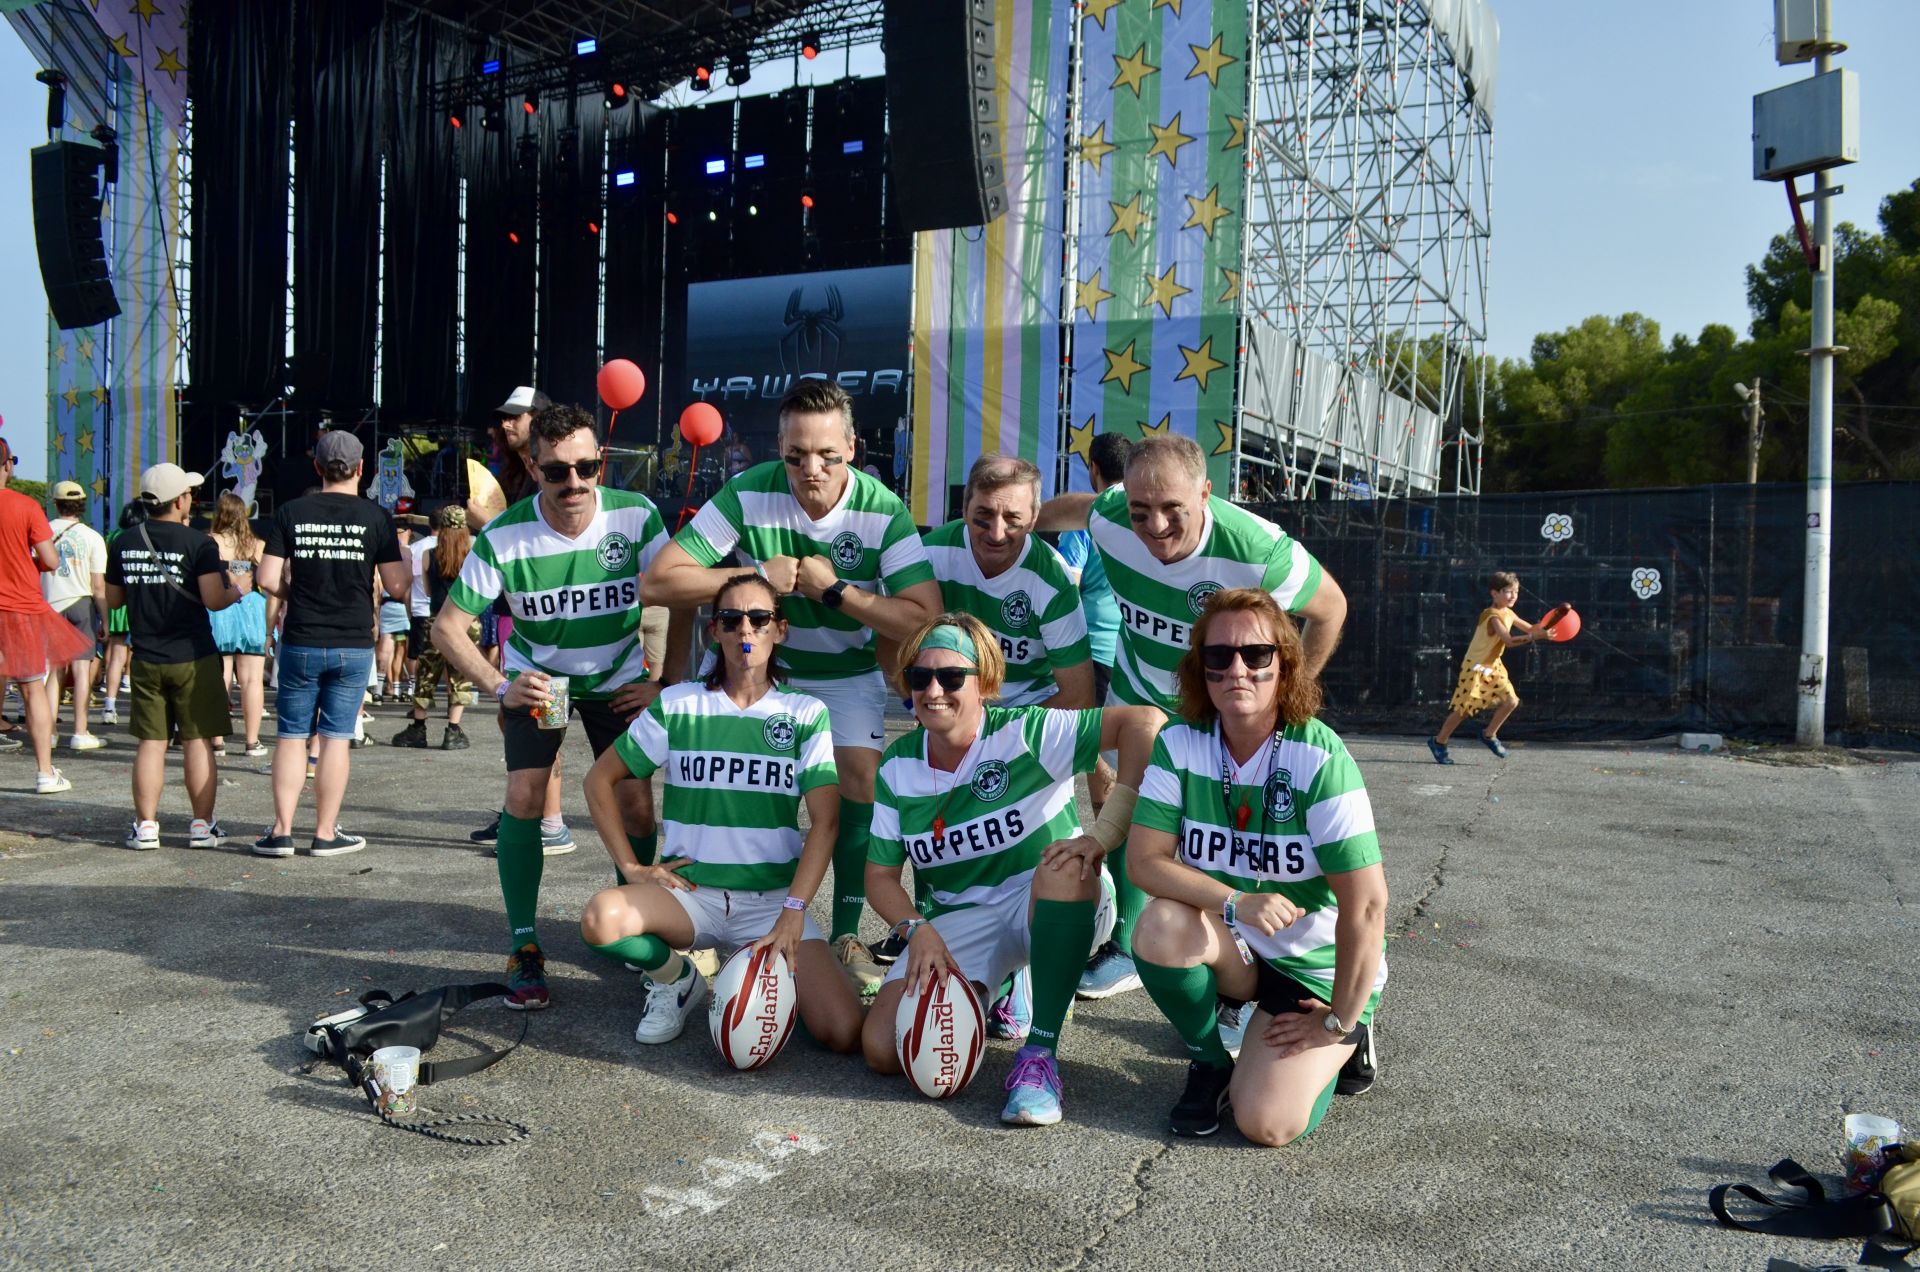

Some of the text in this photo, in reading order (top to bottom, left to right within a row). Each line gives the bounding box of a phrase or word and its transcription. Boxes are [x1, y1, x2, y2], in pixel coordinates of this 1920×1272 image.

[295, 523, 366, 534] SIEMPRE VOY
[164, 552, 184, 562] VOY
[294, 549, 314, 558] HOY
[523, 582, 635, 617] HOPPERS
[680, 756, 793, 789] HOPPERS
[748, 973, 779, 1057] England
[932, 1001, 960, 1088] England
